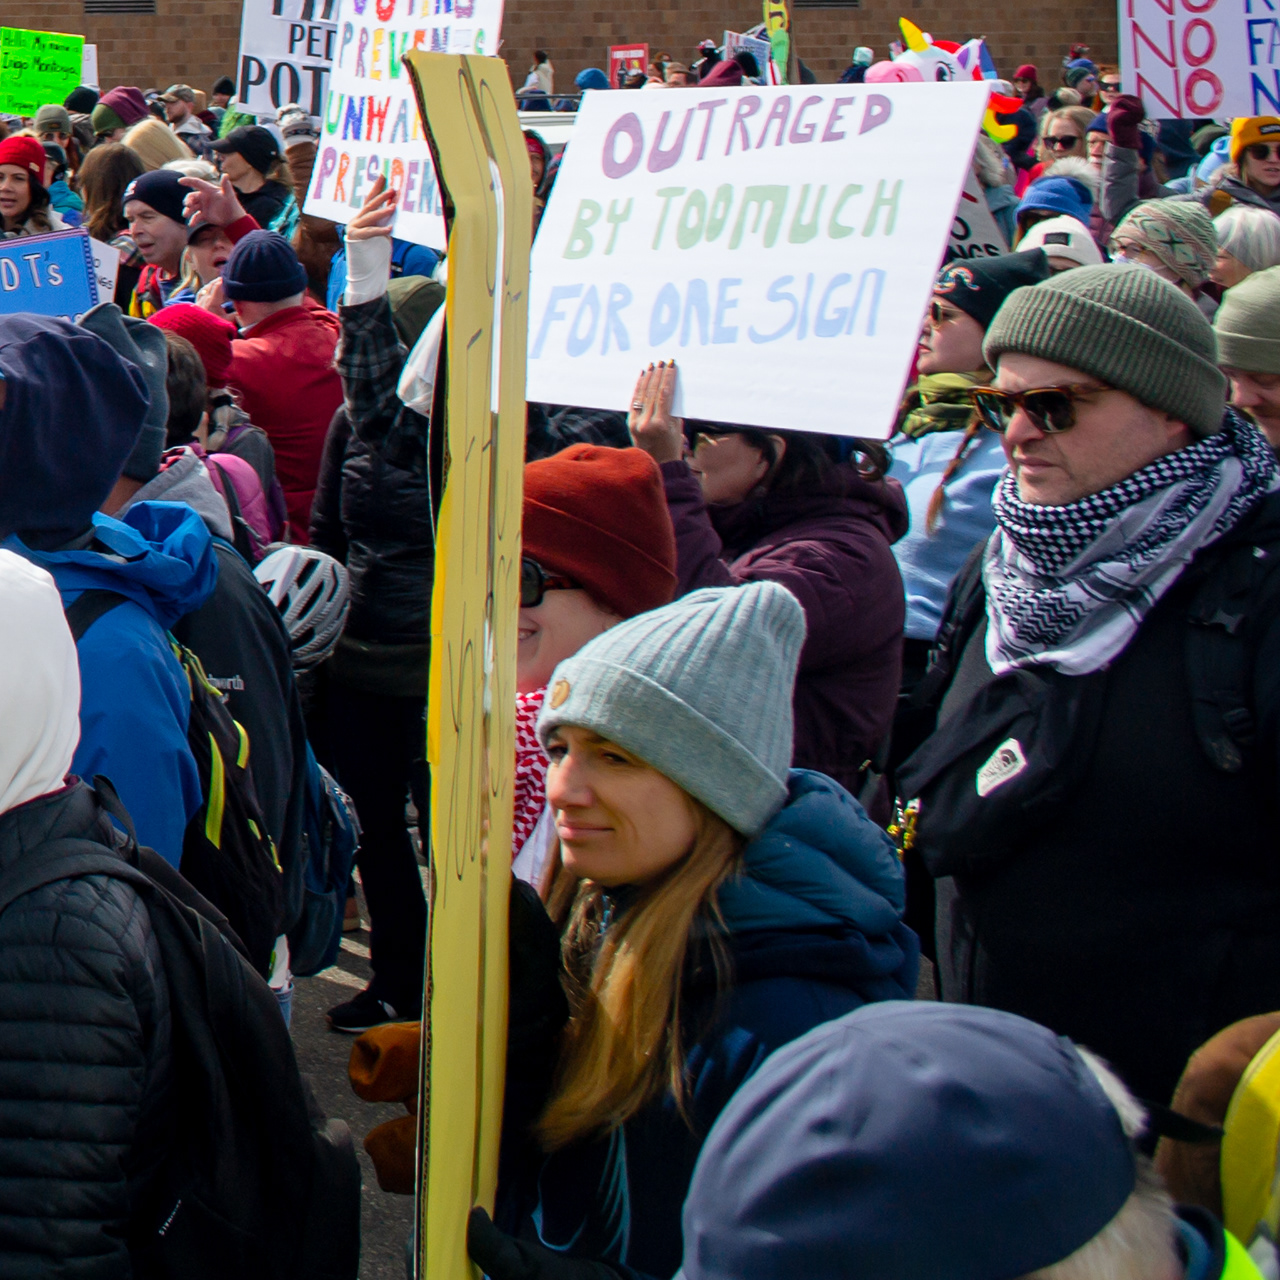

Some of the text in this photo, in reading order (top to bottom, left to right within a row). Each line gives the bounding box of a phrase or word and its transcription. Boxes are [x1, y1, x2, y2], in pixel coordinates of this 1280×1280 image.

[1130, 17, 1217, 69] NO
[1134, 68, 1224, 120] NO
[601, 93, 893, 180] OUTRAGED
[312, 146, 443, 217] PRESIDEN
[561, 197, 634, 260] BY
[527, 282, 633, 361] FOR
[647, 276, 744, 349] ONE
